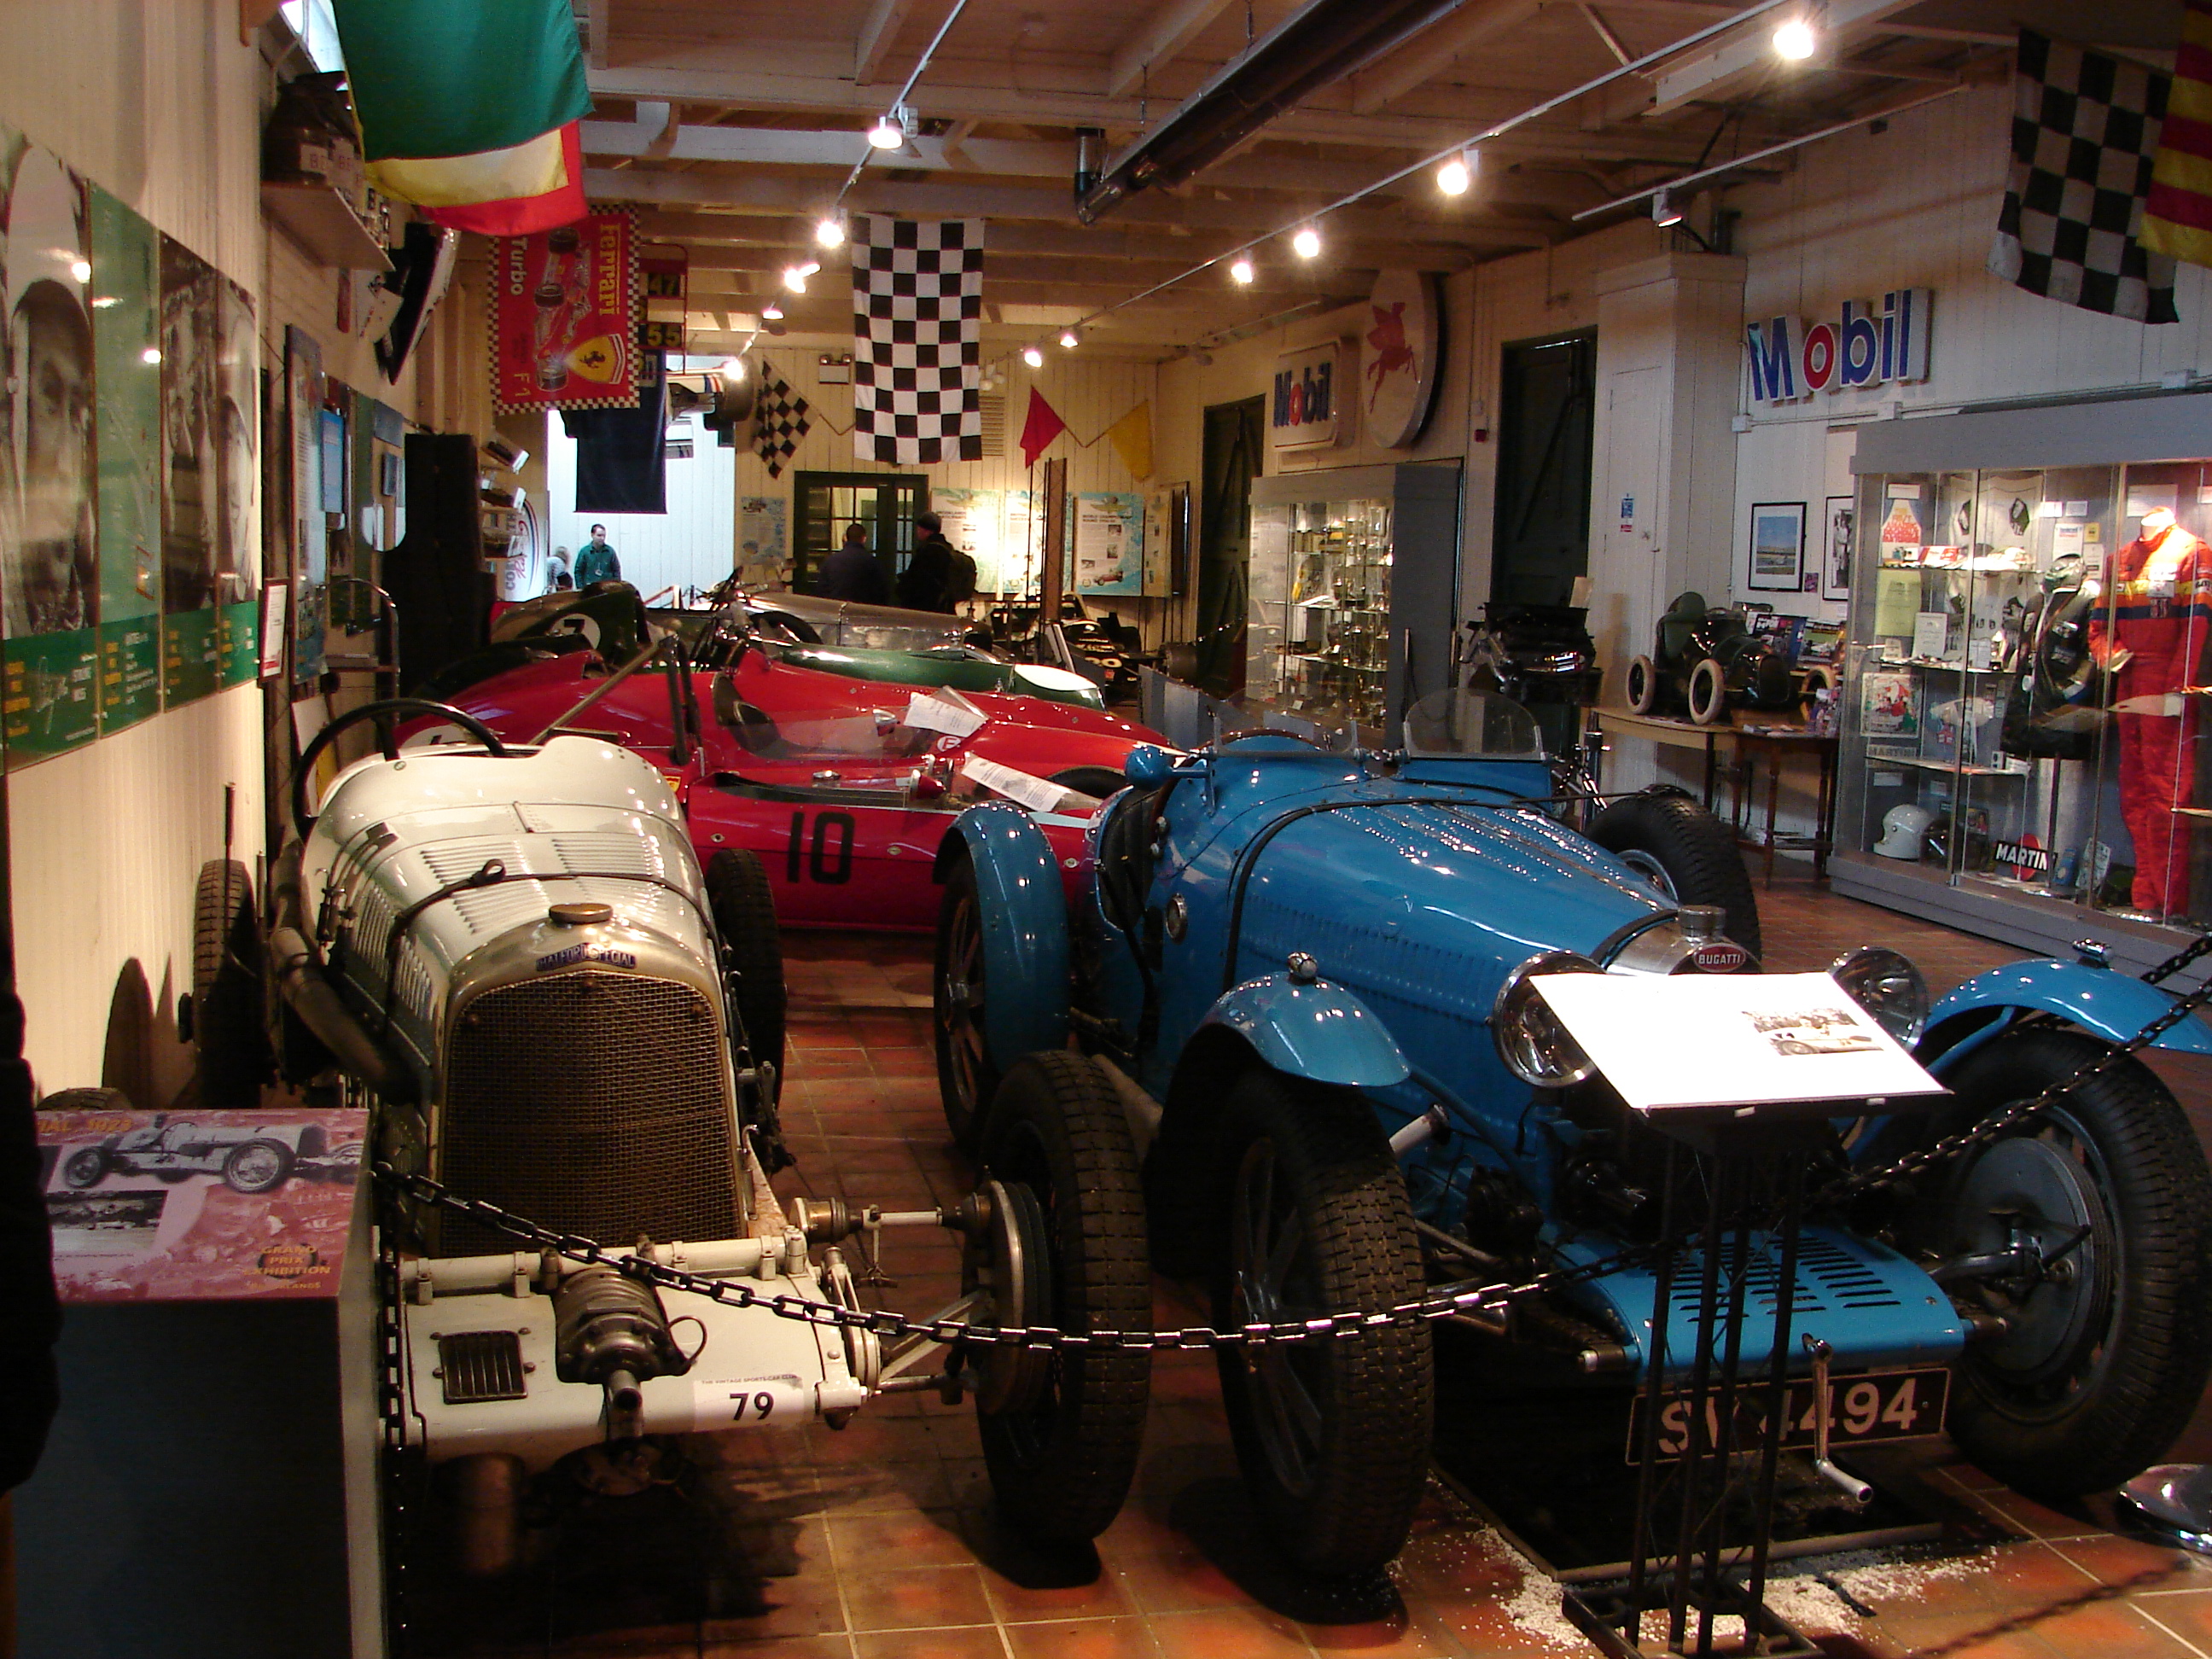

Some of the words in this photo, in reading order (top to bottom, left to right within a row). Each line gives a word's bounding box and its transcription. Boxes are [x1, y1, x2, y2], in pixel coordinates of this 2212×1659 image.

[510, 236, 528, 296] Turbo
[599, 223, 620, 315] Ferrari
[648, 324, 682, 346] 55
[1747, 288, 1912, 401] Mobil
[1273, 362, 1331, 428] Mobil
[787, 812, 855, 885] 10
[591, 946, 635, 967] SPECIAL
[1698, 954, 1740, 964] BUGATTI
[261, 1246, 317, 1254] GRAND
[243, 1266, 331, 1275] EXHIBITION
[730, 1391, 774, 1421] 79
